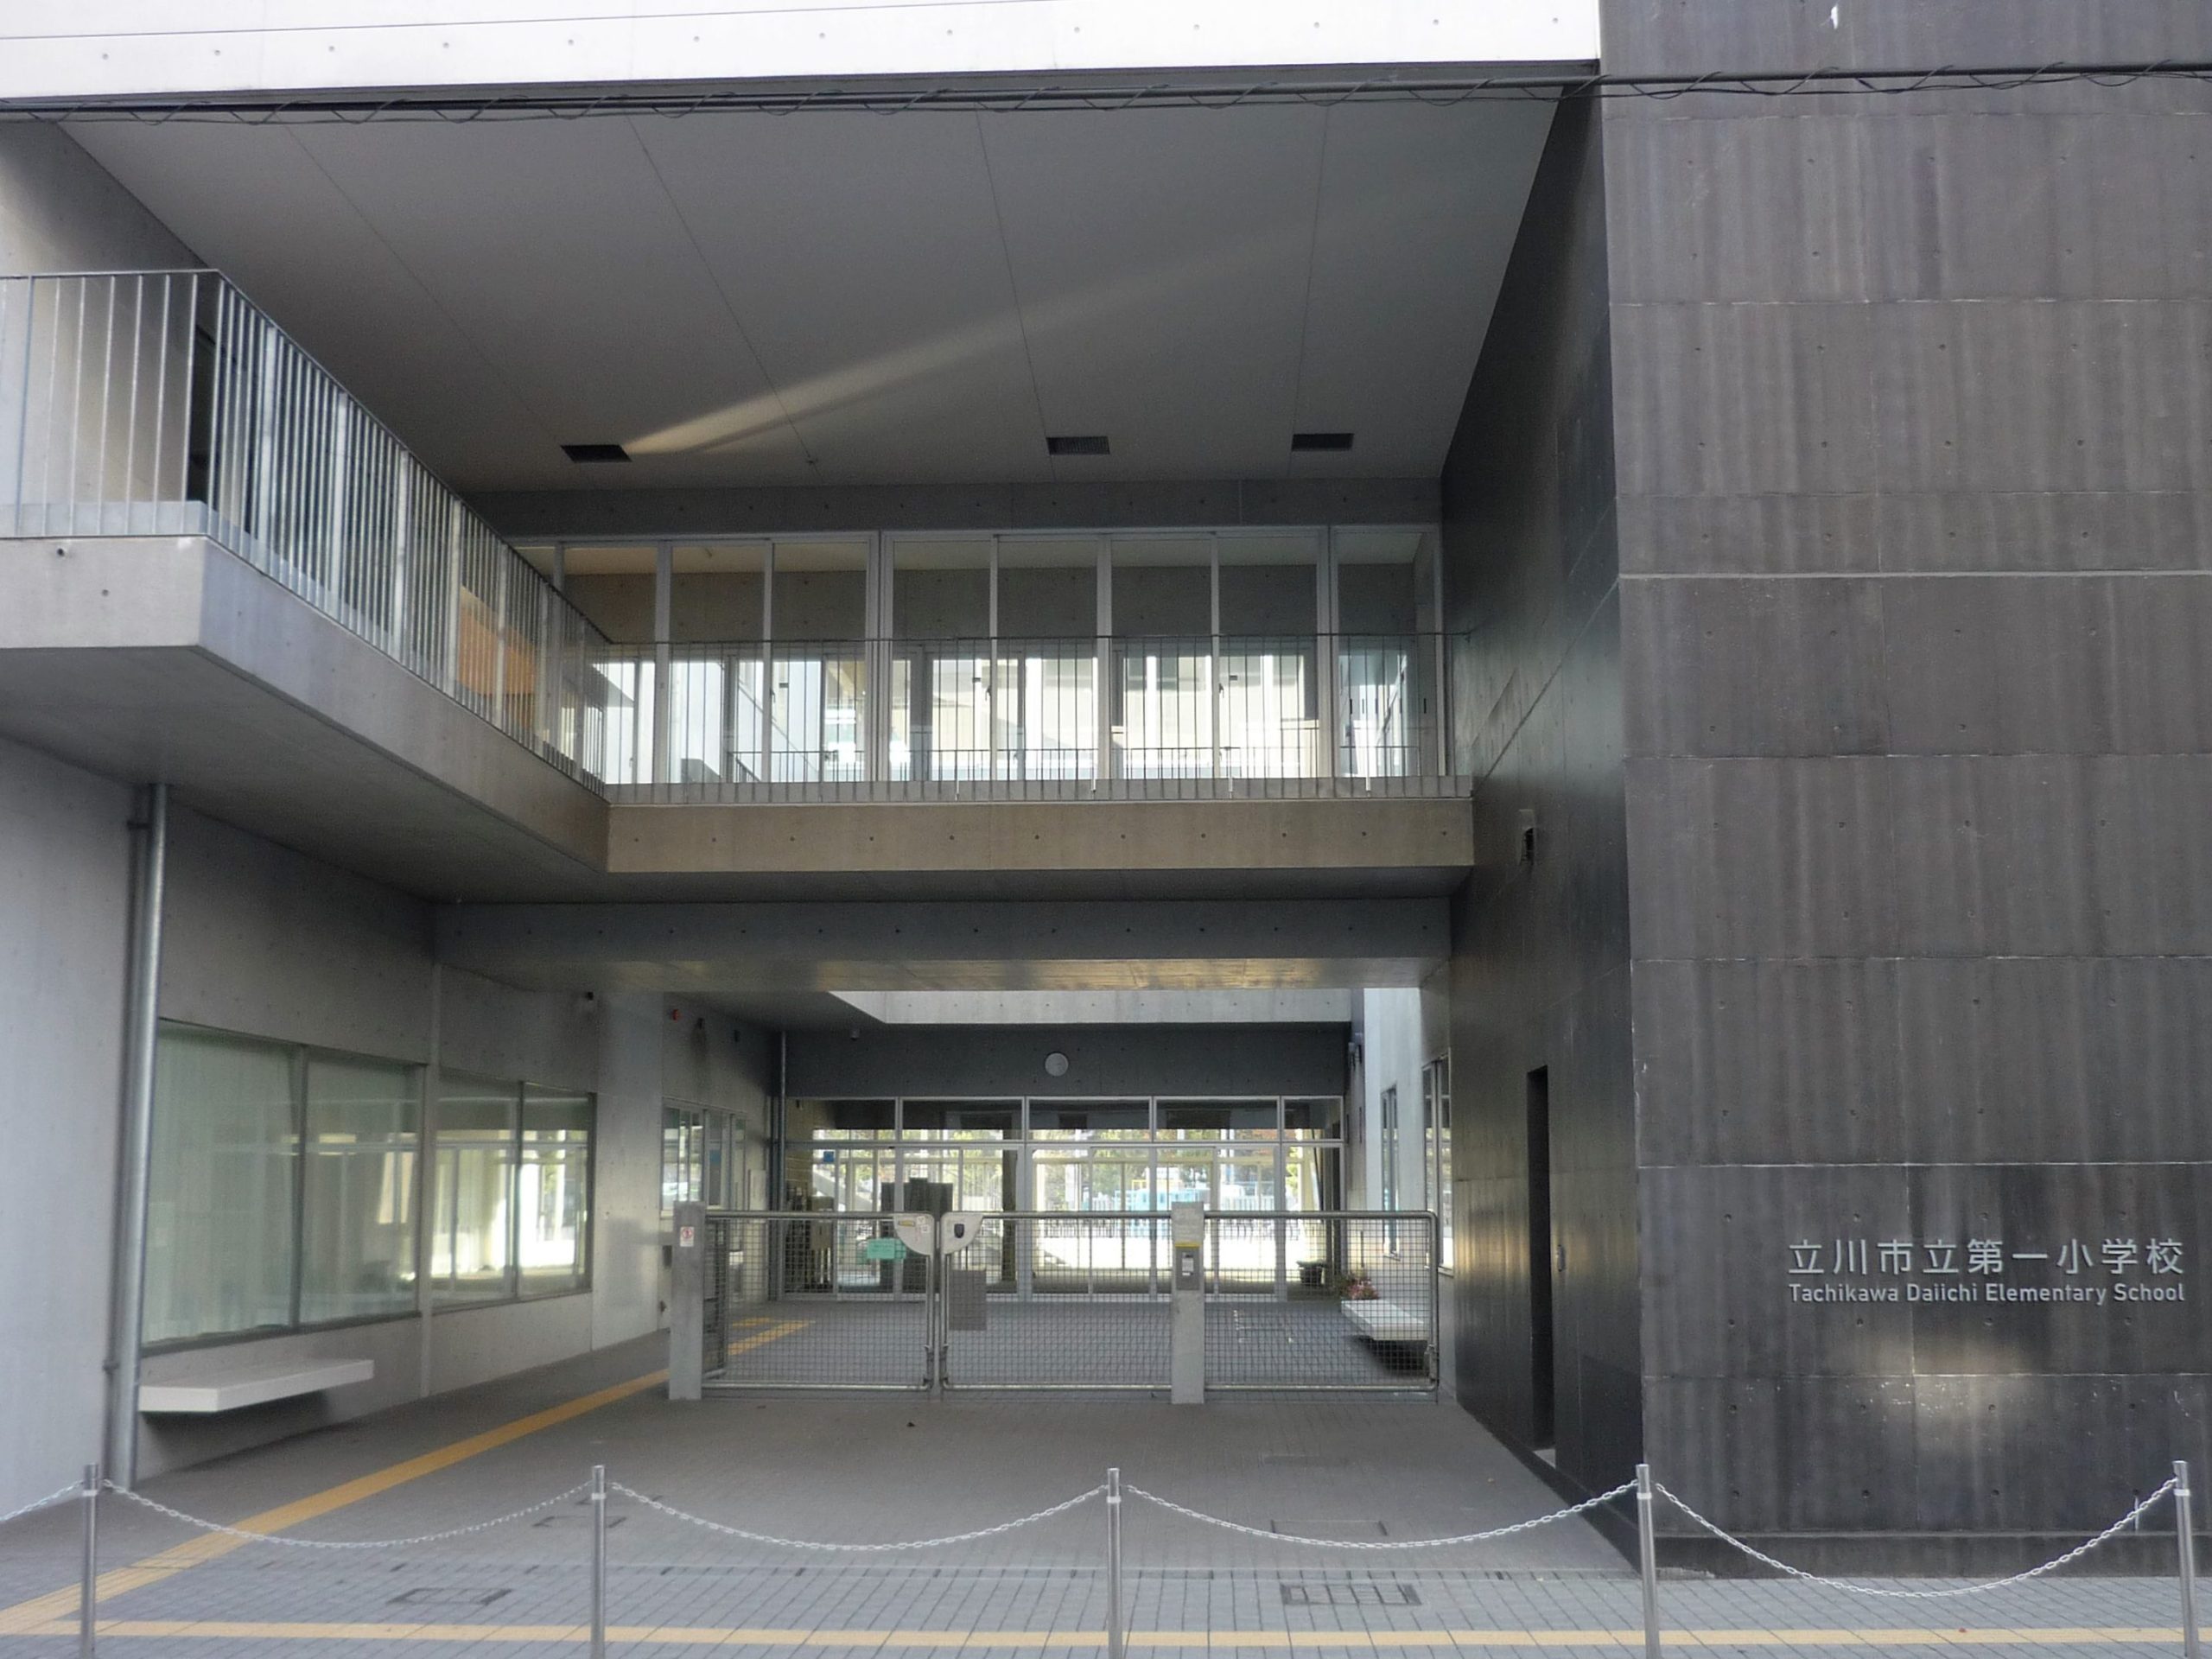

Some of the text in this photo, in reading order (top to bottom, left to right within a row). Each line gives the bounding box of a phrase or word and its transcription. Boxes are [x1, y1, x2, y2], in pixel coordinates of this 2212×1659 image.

[1789, 1238, 2183, 1275] 立川市立第一小学校
[1789, 1282, 2184, 1306] Tachikawa Daiichi Elementary School
